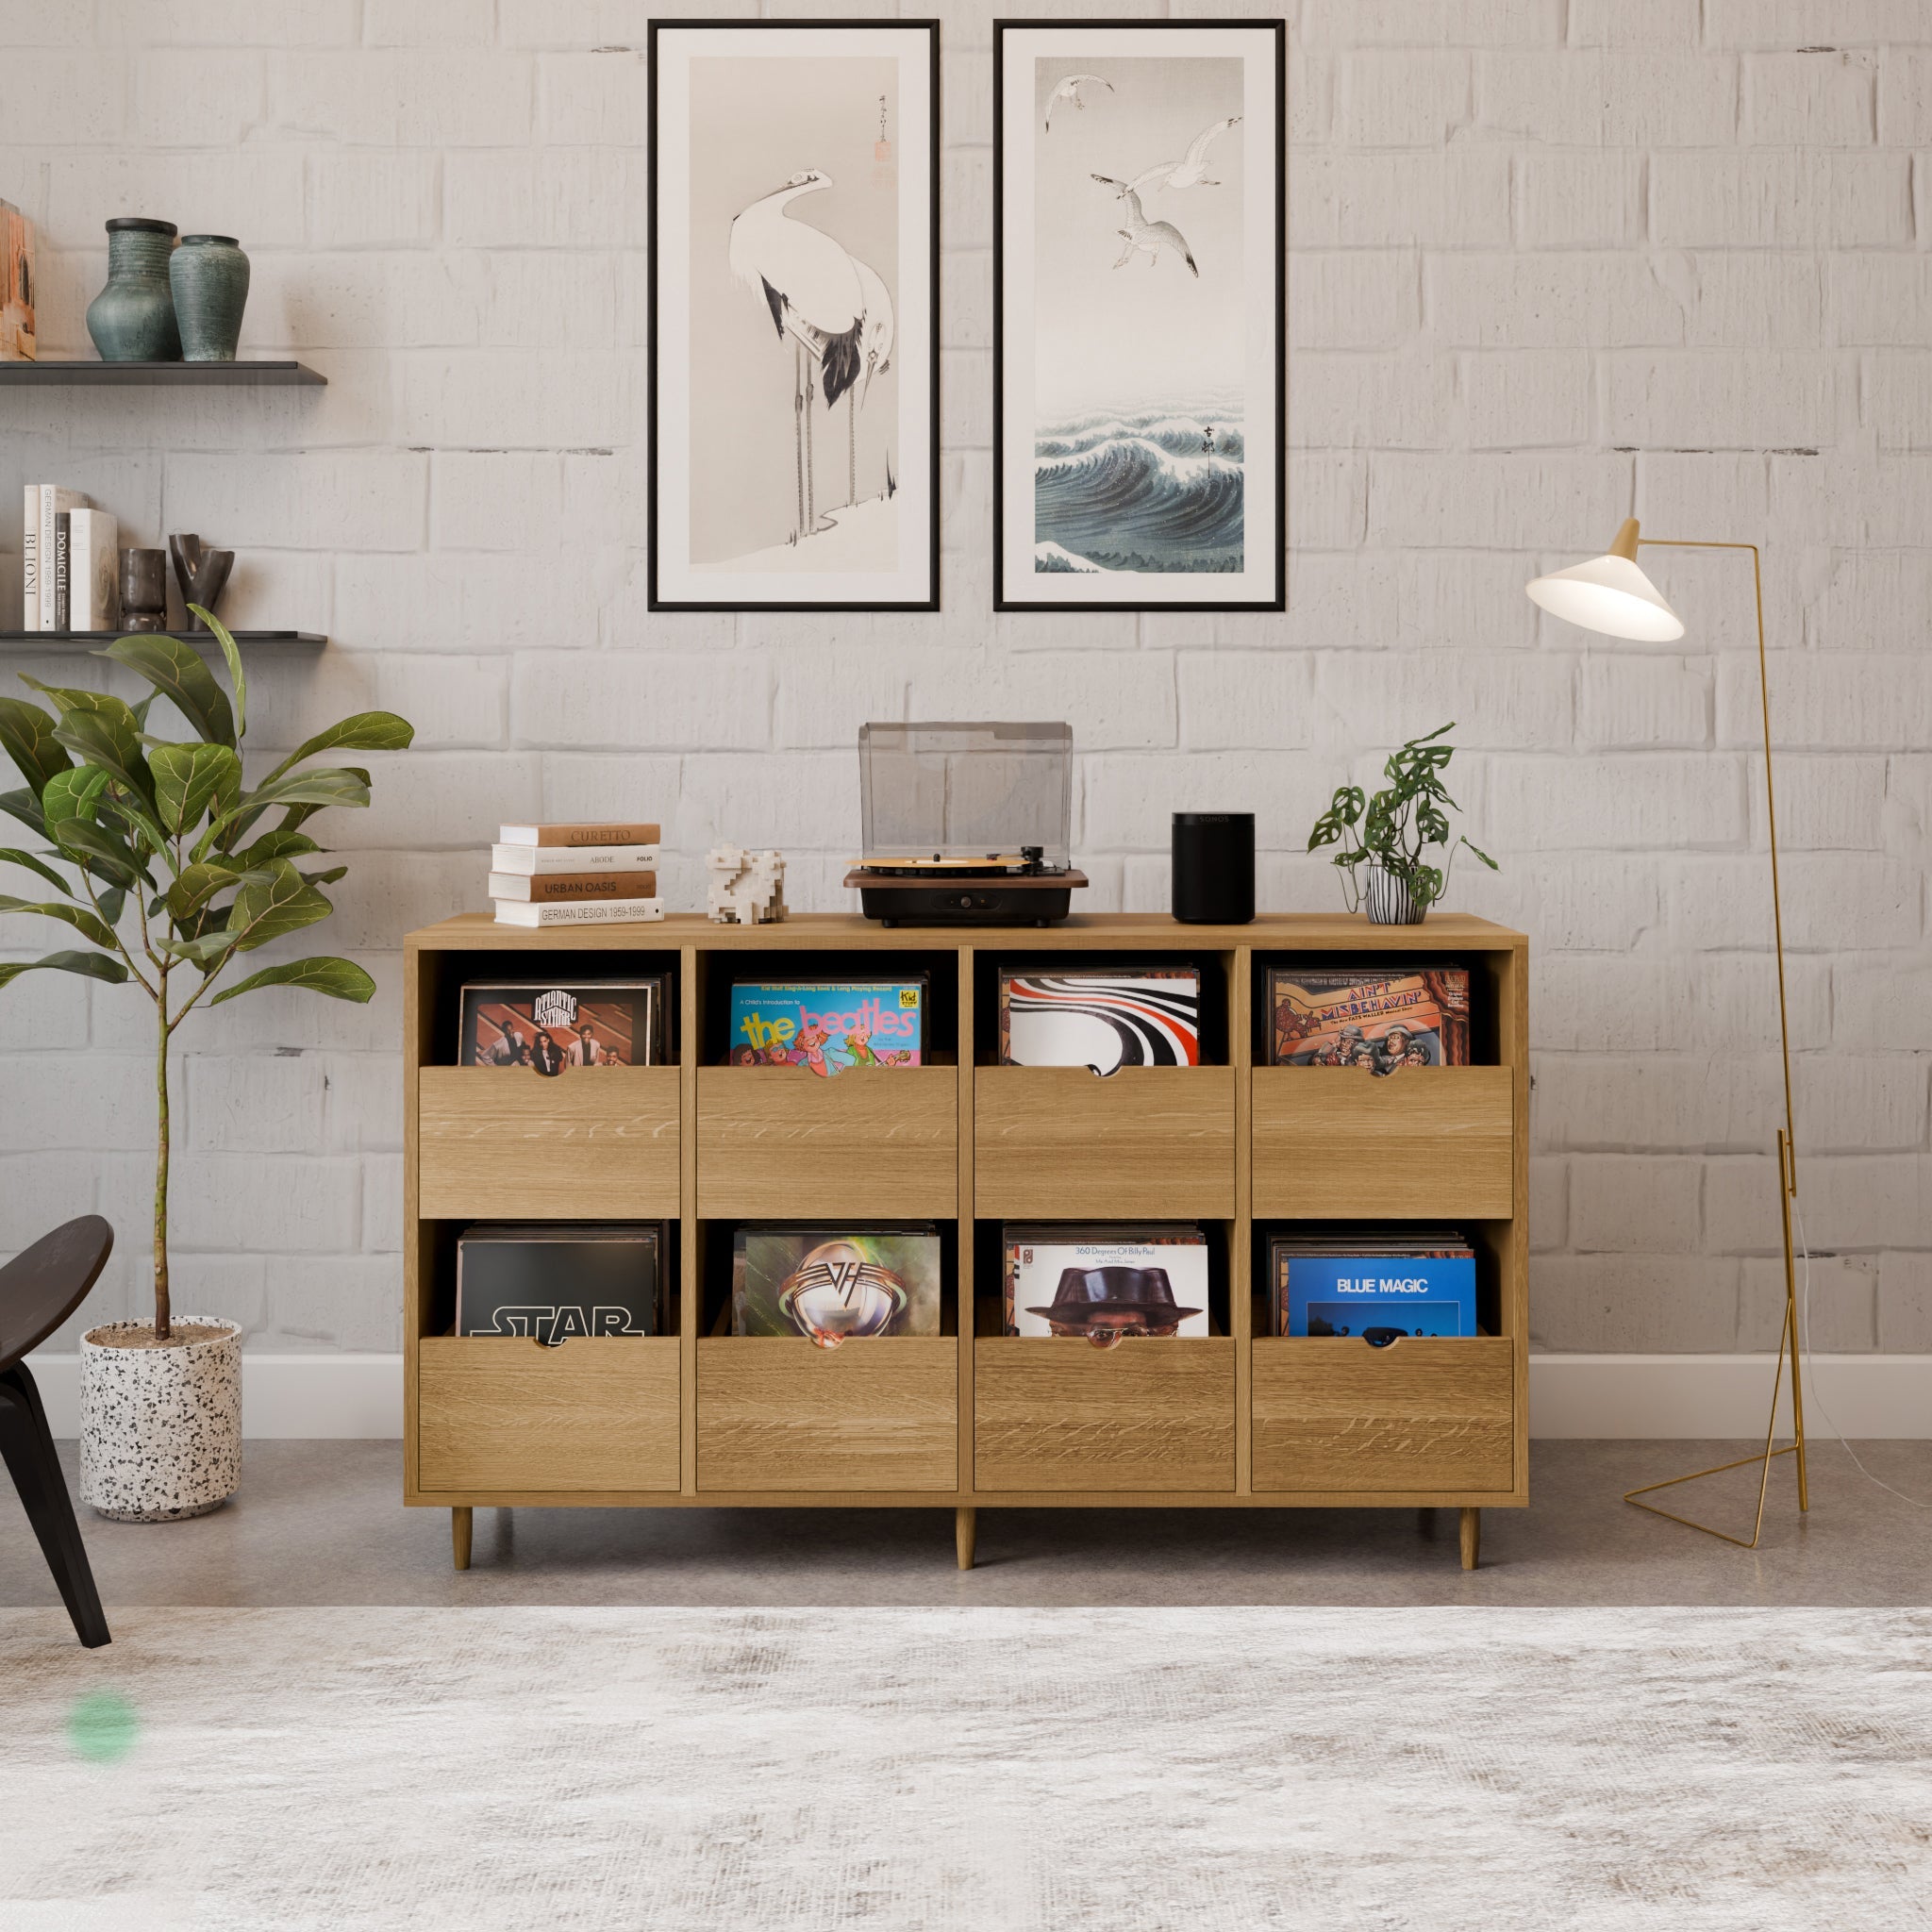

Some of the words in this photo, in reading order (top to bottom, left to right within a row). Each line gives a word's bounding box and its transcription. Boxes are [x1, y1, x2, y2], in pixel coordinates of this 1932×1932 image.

[25, 533, 36, 595] BLIONI
[57, 531, 66, 591] DOMICILE
[571, 829, 631, 841] CURETTO
[544, 883, 582, 893] URBAN
[585, 882, 616, 892] OASIS
[541, 908, 575, 921] GERMAN
[577, 907, 608, 919] DESIGN
[609, 906, 645, 918] 1959-1999
[900, 991, 916, 1001] Kid
[1348, 982, 1391, 1001] AIN'T
[534, 990, 576, 1021] ATLANTIC
[1321, 991, 1422, 1021] MISBEHAVIN'
[541, 1007, 571, 1026] STARR
[740, 1012, 795, 1050] the
[799, 997, 917, 1037] beatles
[1075, 1246, 1091, 1255] 360
[1091, 1246, 1116, 1256] Degrees
[1117, 1246, 1128, 1255] Of
[1128, 1246, 1142, 1256] Billy
[1142, 1247, 1156, 1256] Paul
[1337, 1278, 1375, 1293] BLUE
[1379, 1278, 1429, 1293] MAGIC
[469, 1307, 645, 1345] STAR
